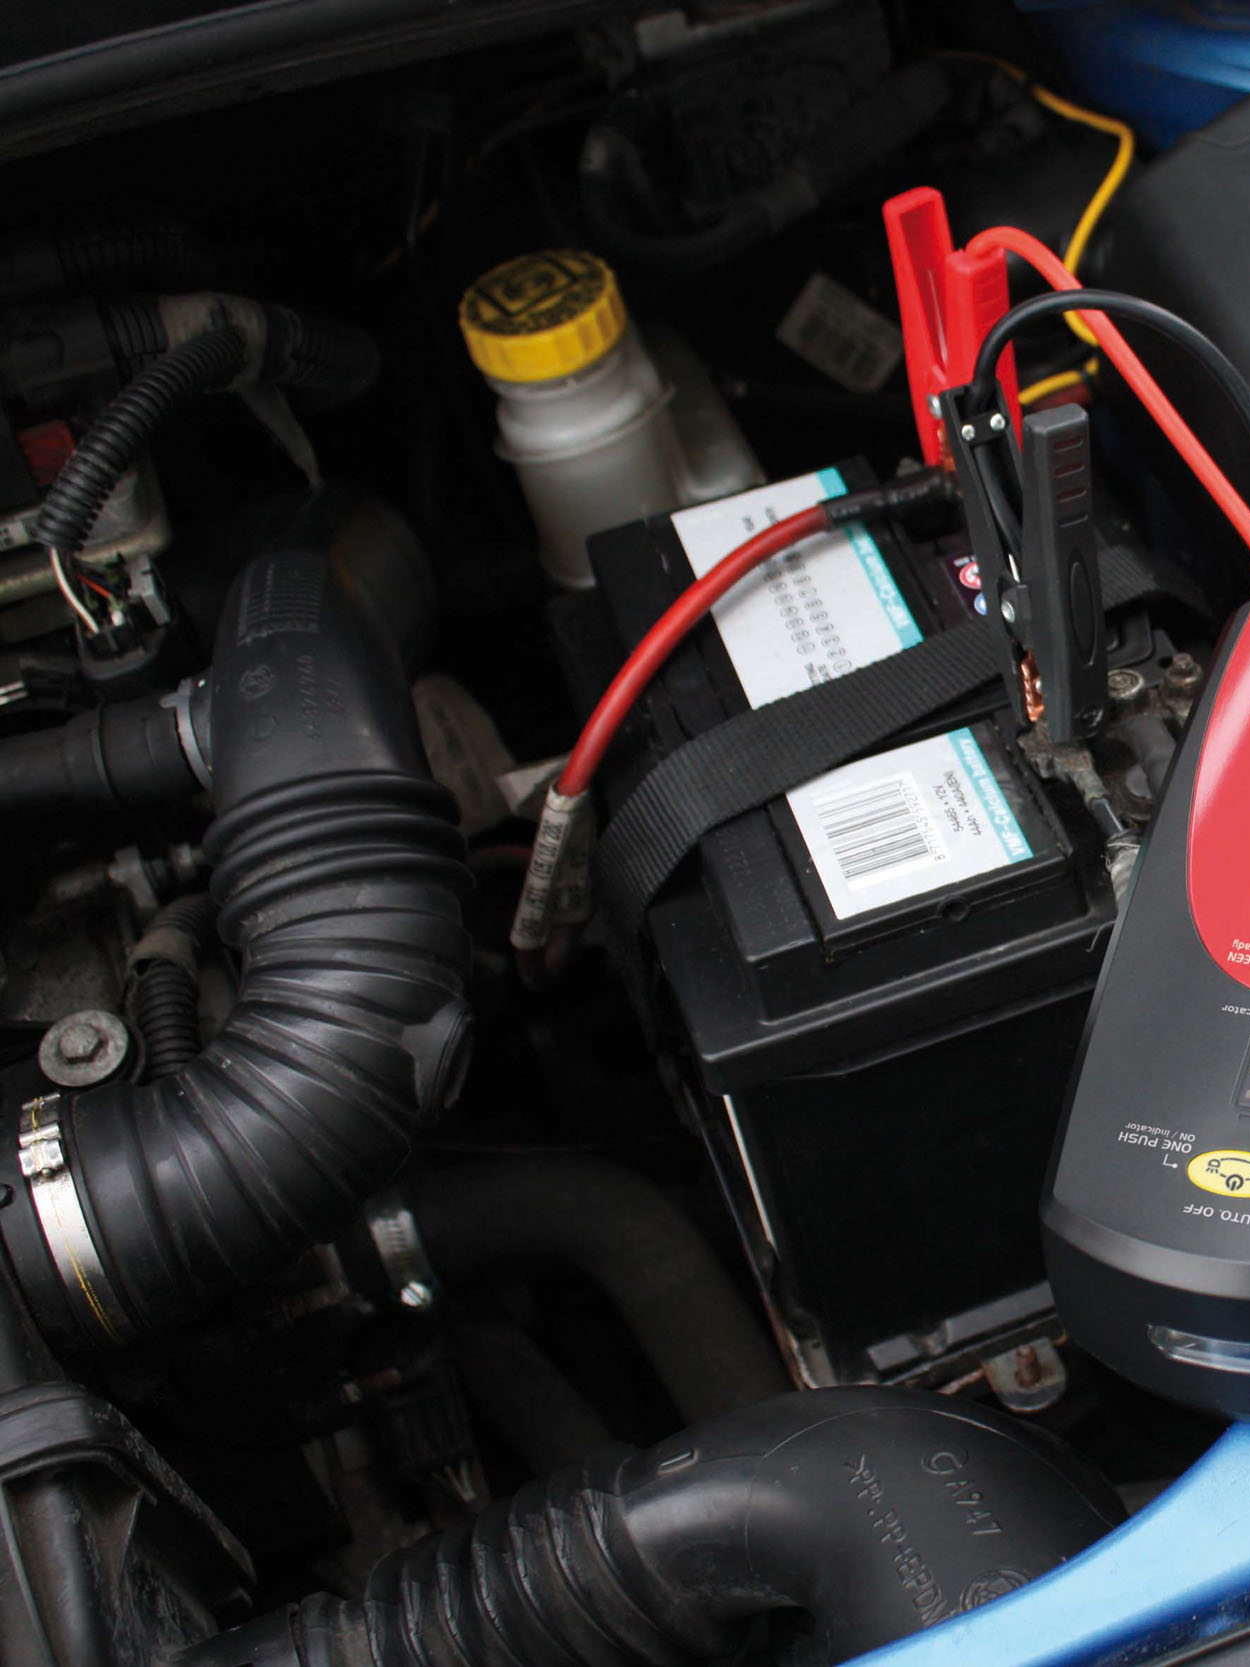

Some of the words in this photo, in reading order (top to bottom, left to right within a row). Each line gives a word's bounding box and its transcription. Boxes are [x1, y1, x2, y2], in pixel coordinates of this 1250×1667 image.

[954, 734, 989, 780] battery
[932, 781, 950, 802] 12V
[1118, 1131, 1159, 1148] PUSH
[1179, 1132, 1196, 1142] ON
[1161, 1139, 1192, 1154] ONE
[1183, 1203, 1215, 1218] OFF
